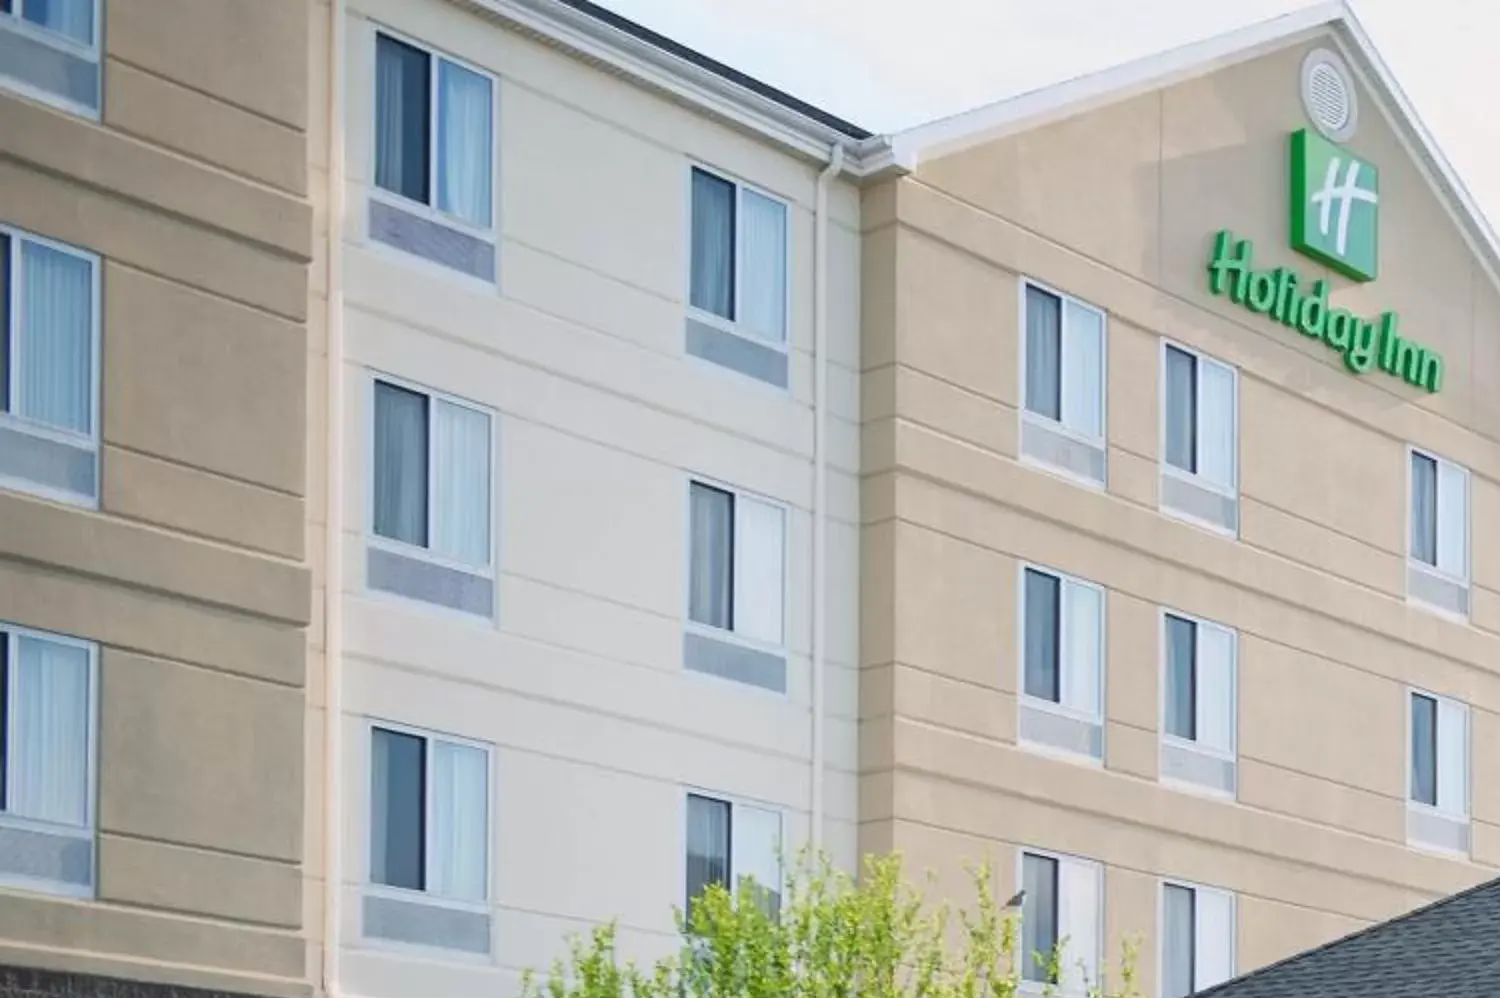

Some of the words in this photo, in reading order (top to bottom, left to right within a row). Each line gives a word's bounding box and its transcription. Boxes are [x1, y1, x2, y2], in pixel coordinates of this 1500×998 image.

[1311, 157, 1377, 255] H
[1208, 230, 1376, 373] Holiday
[1377, 311, 1442, 392] Inn
